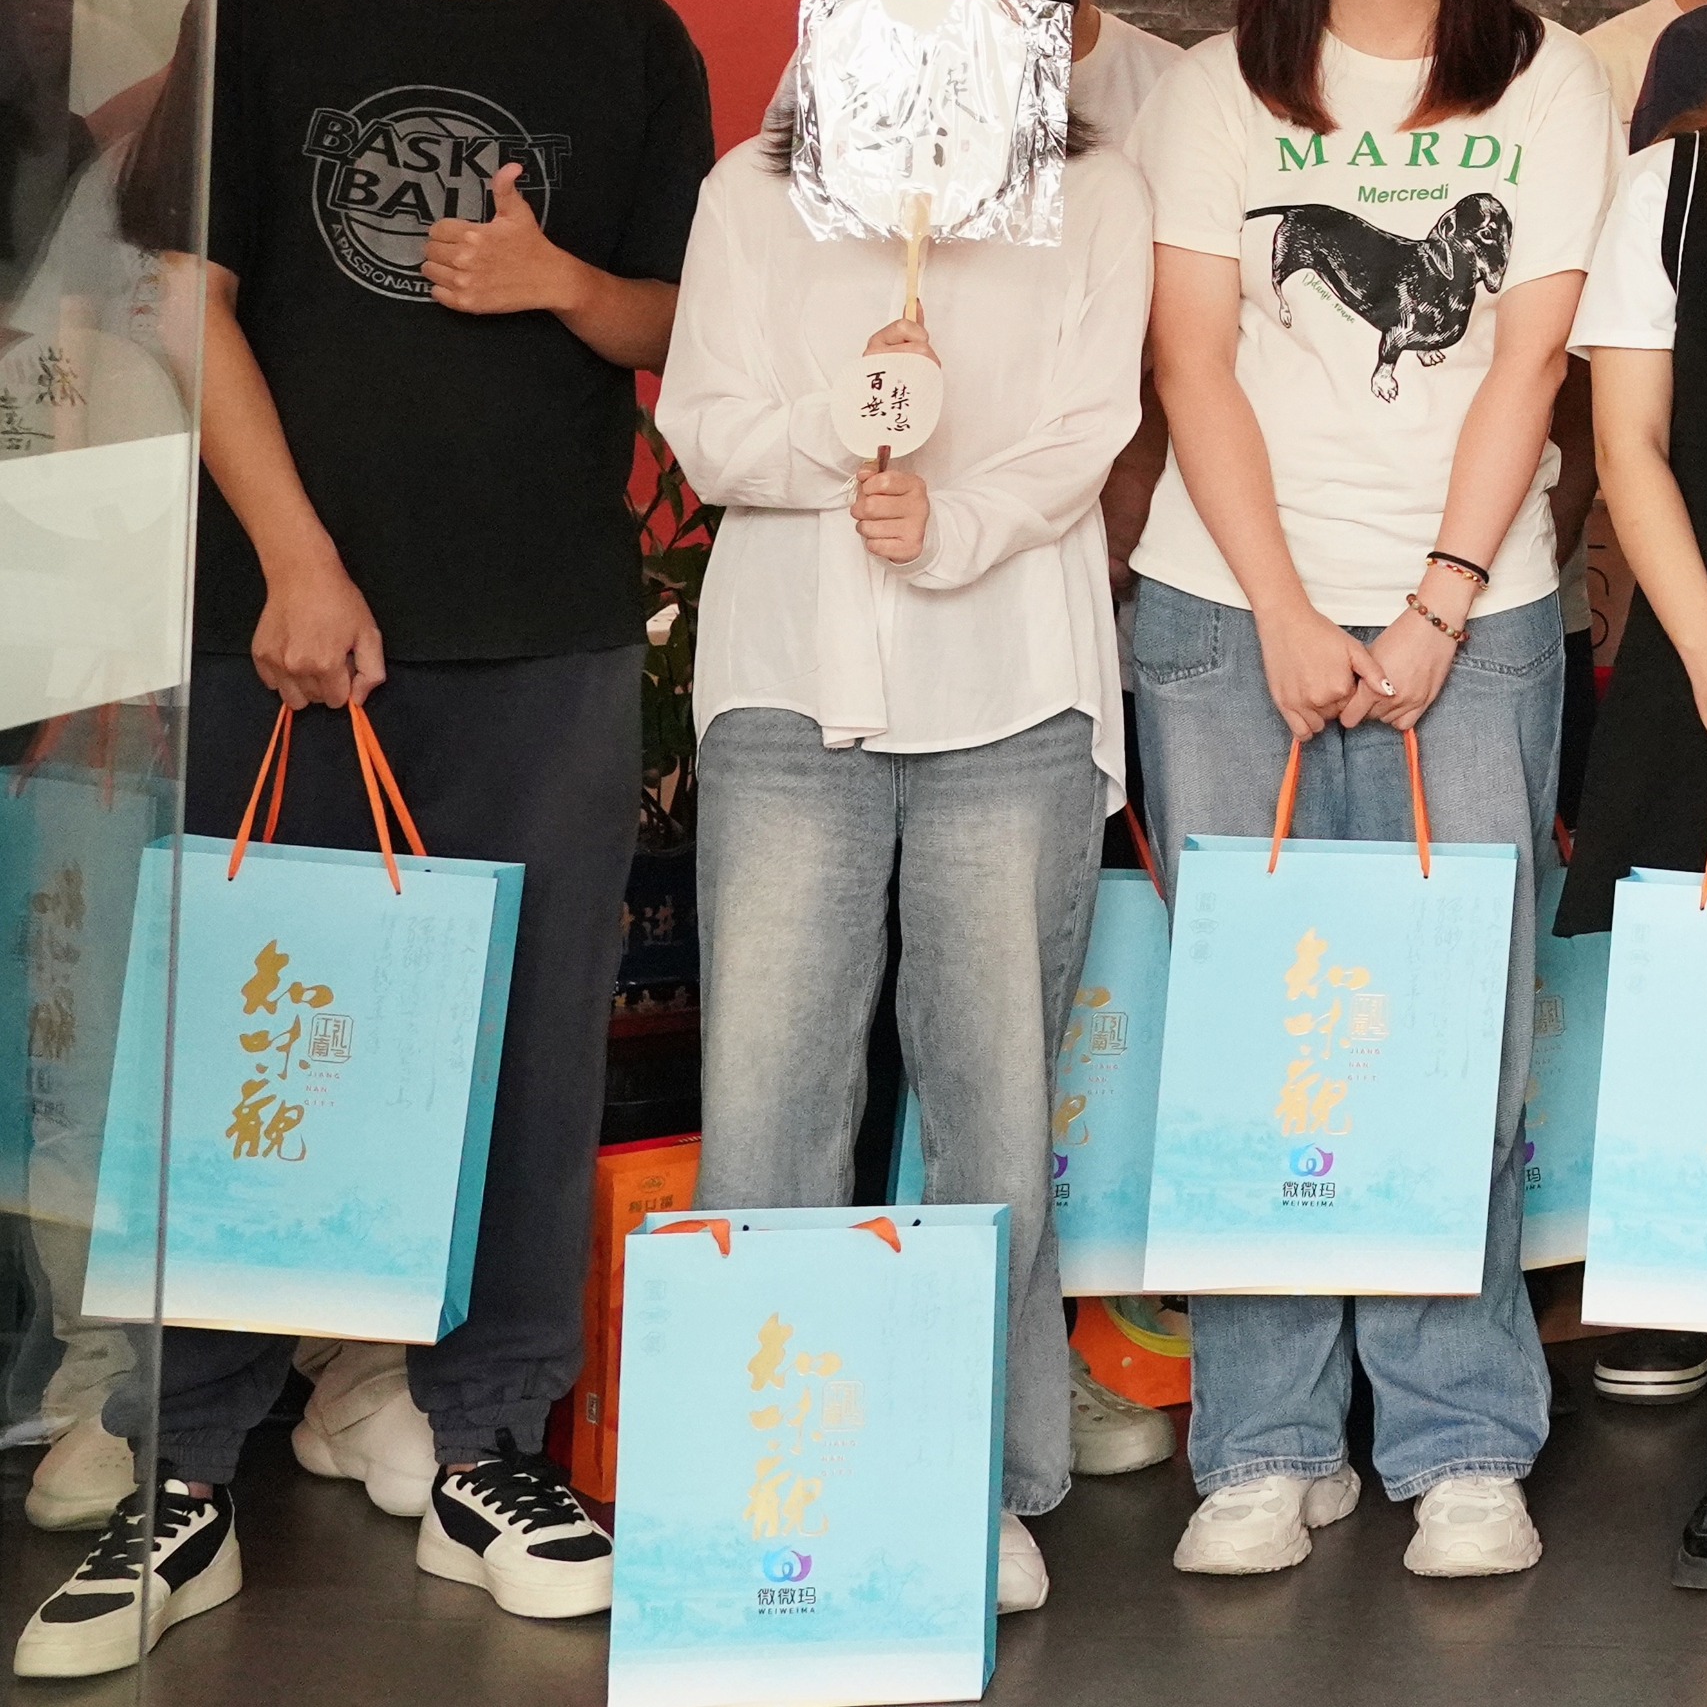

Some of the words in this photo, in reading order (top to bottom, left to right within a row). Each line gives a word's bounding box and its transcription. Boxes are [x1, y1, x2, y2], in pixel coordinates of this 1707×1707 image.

[302, 107, 572, 189] BASKET
[1275, 131, 1523, 185] MARDI
[1357, 183, 1449, 204] Mercredi
[1282, 1181, 1336, 1199] 微微玛
[1282, 1200, 1334, 1208] WEIWEIMA
[757, 1587, 816, 1605] 微微玛
[758, 1606, 816, 1615] WEIWEIMA
